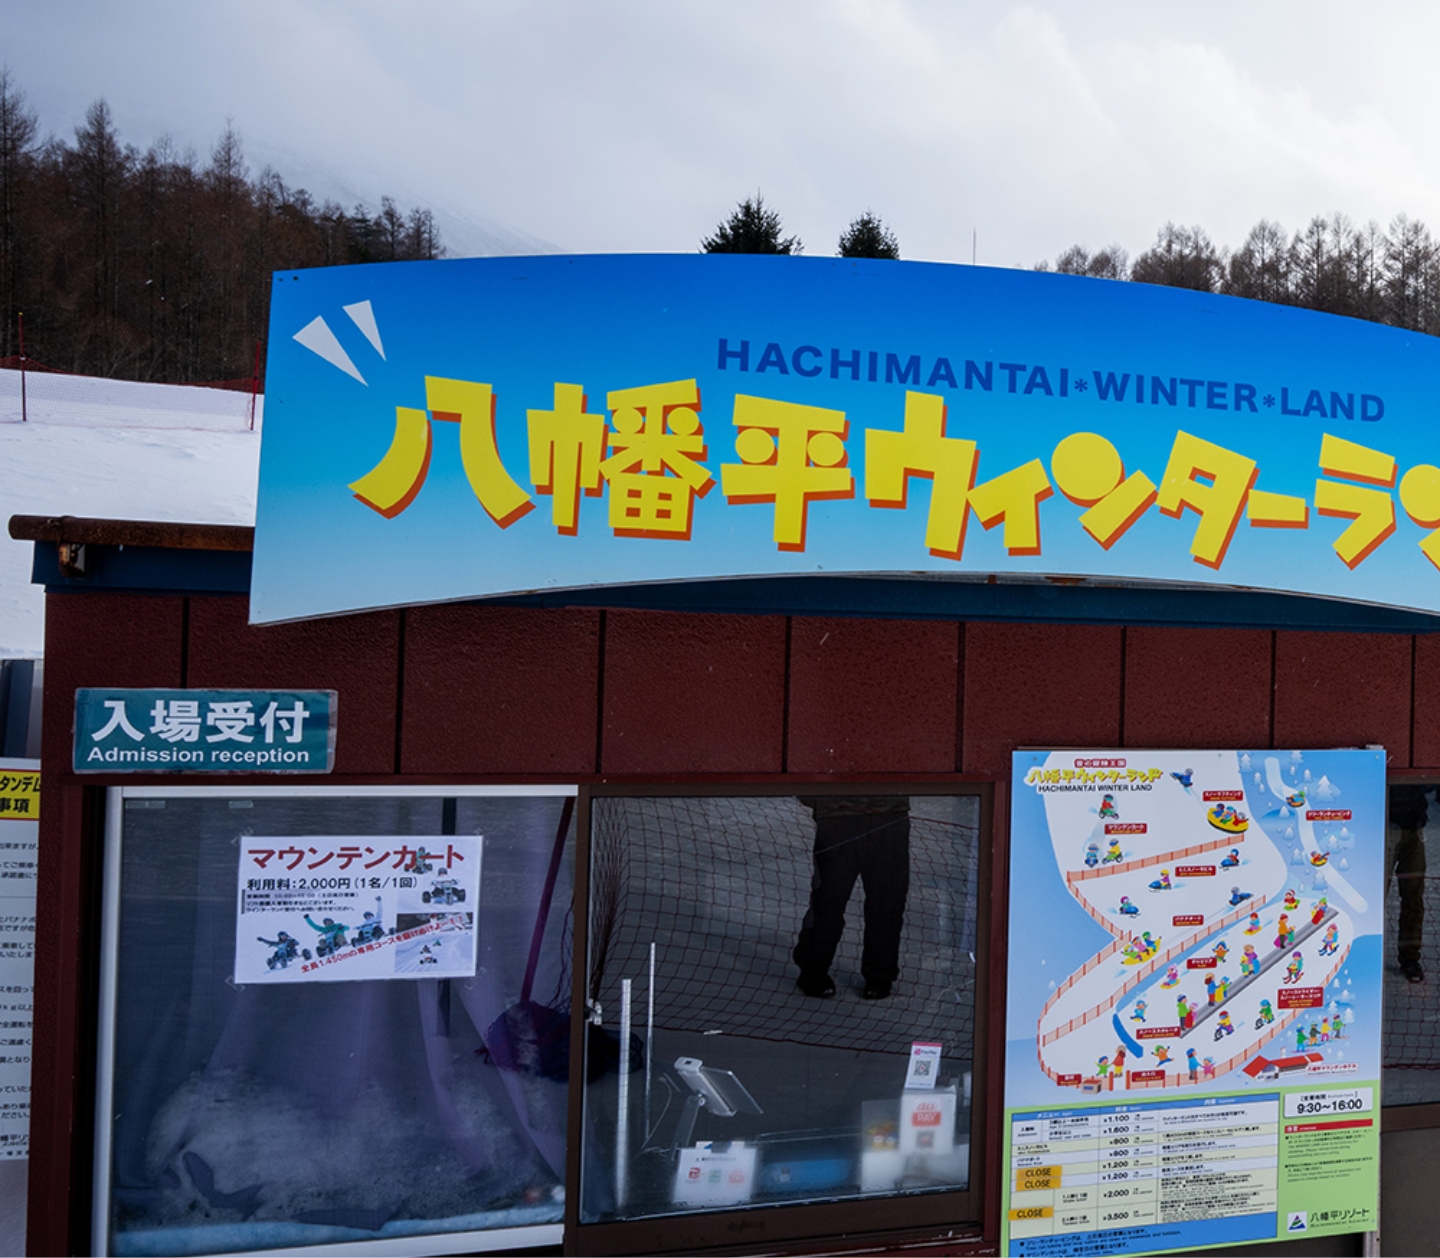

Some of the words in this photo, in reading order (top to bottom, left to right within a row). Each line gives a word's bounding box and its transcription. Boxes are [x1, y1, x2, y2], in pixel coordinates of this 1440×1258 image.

[718, 338, 1070, 397] HACHIMANTAI
[1092, 370, 1259, 413] WINTER
[1280, 386, 1386, 422] LAND
[91, 700, 310, 744] 入場受付
[87, 747, 204, 763] Admission
[211, 748, 310, 766] reception
[1038, 785, 1096, 793] HACHIMANTAI
[1098, 784, 1129, 792] WINTER
[1131, 784, 1153, 792] LAND
[248, 845, 465, 870] マウンテンカート
[916, 1113, 937, 1122] PAY
[1025, 1168, 1051, 1178] CLOSE
[1024, 1179, 1051, 1189] CLOSE
[1016, 1208, 1043, 1218] CLOSE
